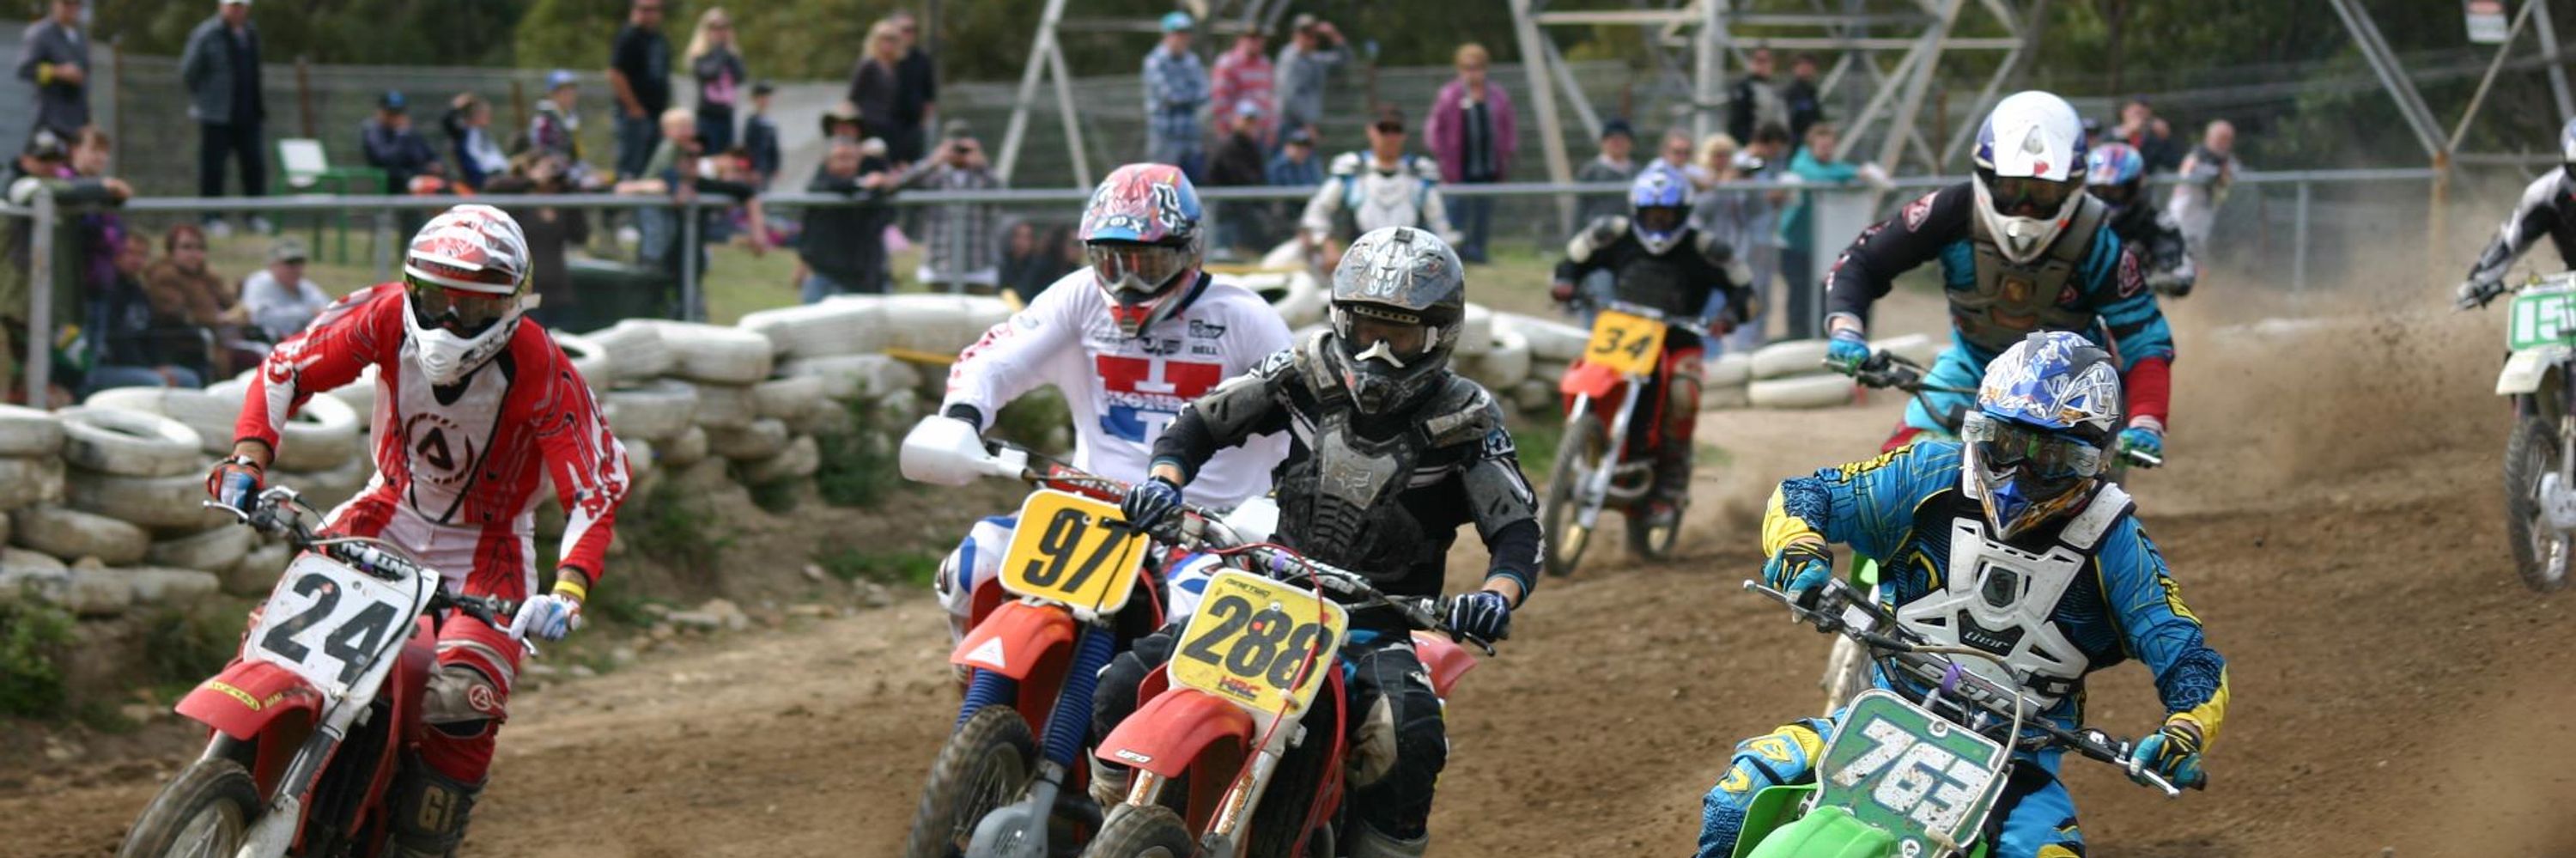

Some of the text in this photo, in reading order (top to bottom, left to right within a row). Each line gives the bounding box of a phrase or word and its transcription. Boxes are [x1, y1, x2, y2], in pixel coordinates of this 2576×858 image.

[1191, 345, 1217, 356] BELL
[1595, 326, 1653, 361] 34
[1023, 508, 1131, 593] 97
[260, 573, 398, 685] 24
[1182, 594, 1334, 691] 288
[1115, 749, 1152, 764] UFO
[1832, 717, 1993, 832] 763
